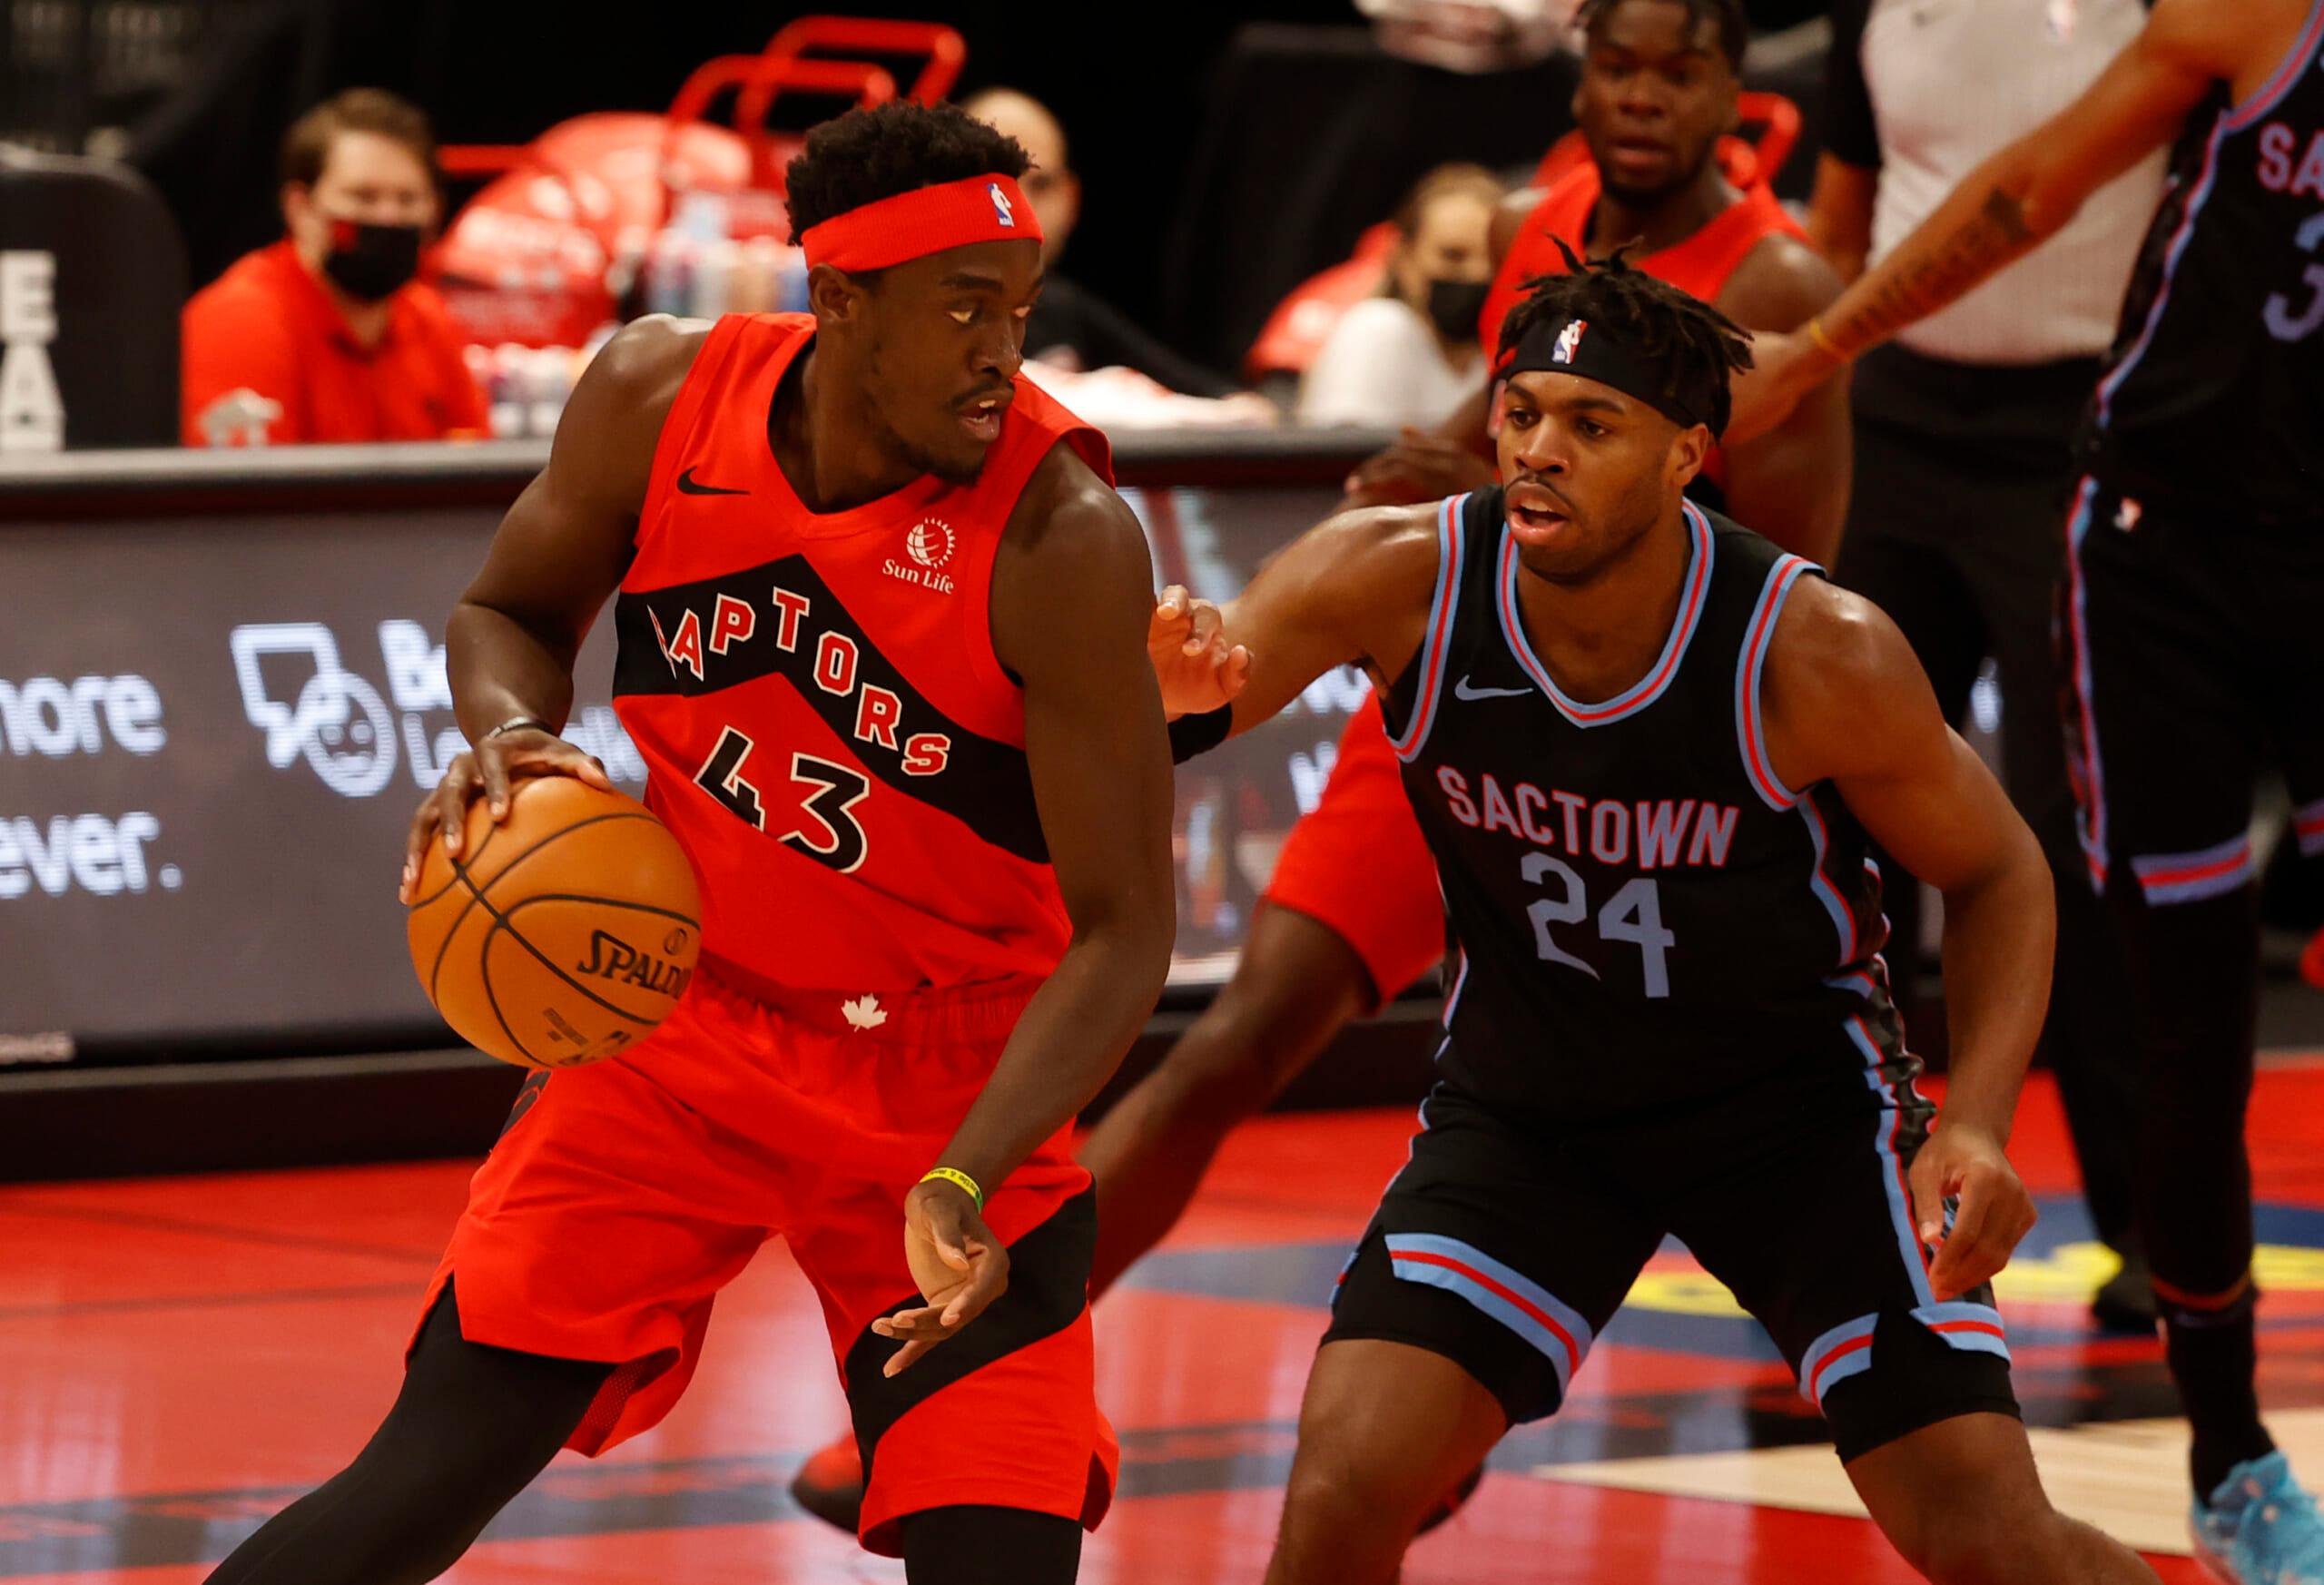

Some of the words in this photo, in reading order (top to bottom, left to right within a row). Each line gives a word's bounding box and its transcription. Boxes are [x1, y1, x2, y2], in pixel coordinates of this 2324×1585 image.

[882, 558, 919, 584] Sun
[922, 570, 954, 596] Life
[646, 586, 950, 776] APTORS
[693, 724, 870, 873] 43
[1436, 764, 1739, 871] SACTOWN
[1521, 851, 1676, 999] 24
